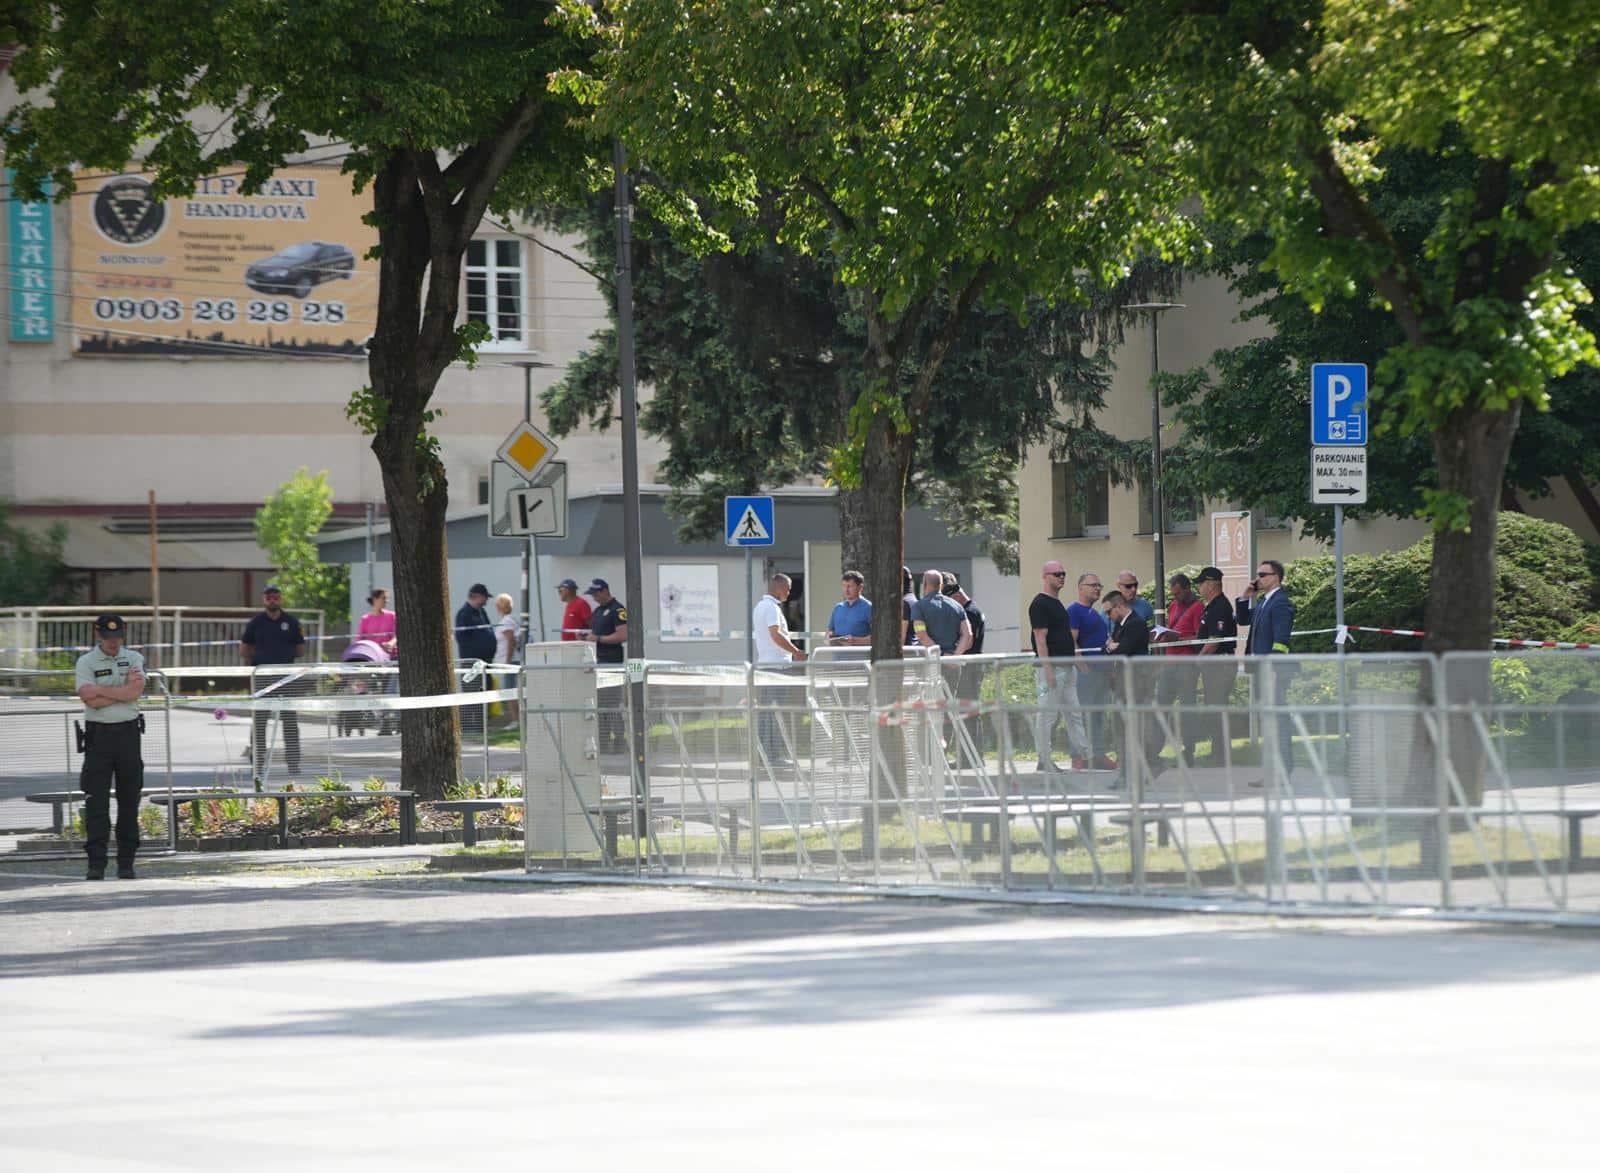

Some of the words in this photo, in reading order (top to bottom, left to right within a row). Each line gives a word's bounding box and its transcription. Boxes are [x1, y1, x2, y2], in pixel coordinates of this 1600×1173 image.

[186, 202, 306, 219] HANDLOVÁ
[95, 298, 181, 320] 0903
[194, 300, 235, 321] 26
[249, 301, 289, 322] 28
[302, 302, 345, 323] 28
[1327, 374, 1352, 418] P
[1315, 454, 1365, 463] PARKOVANIE
[1316, 467, 1336, 477] MAX.
